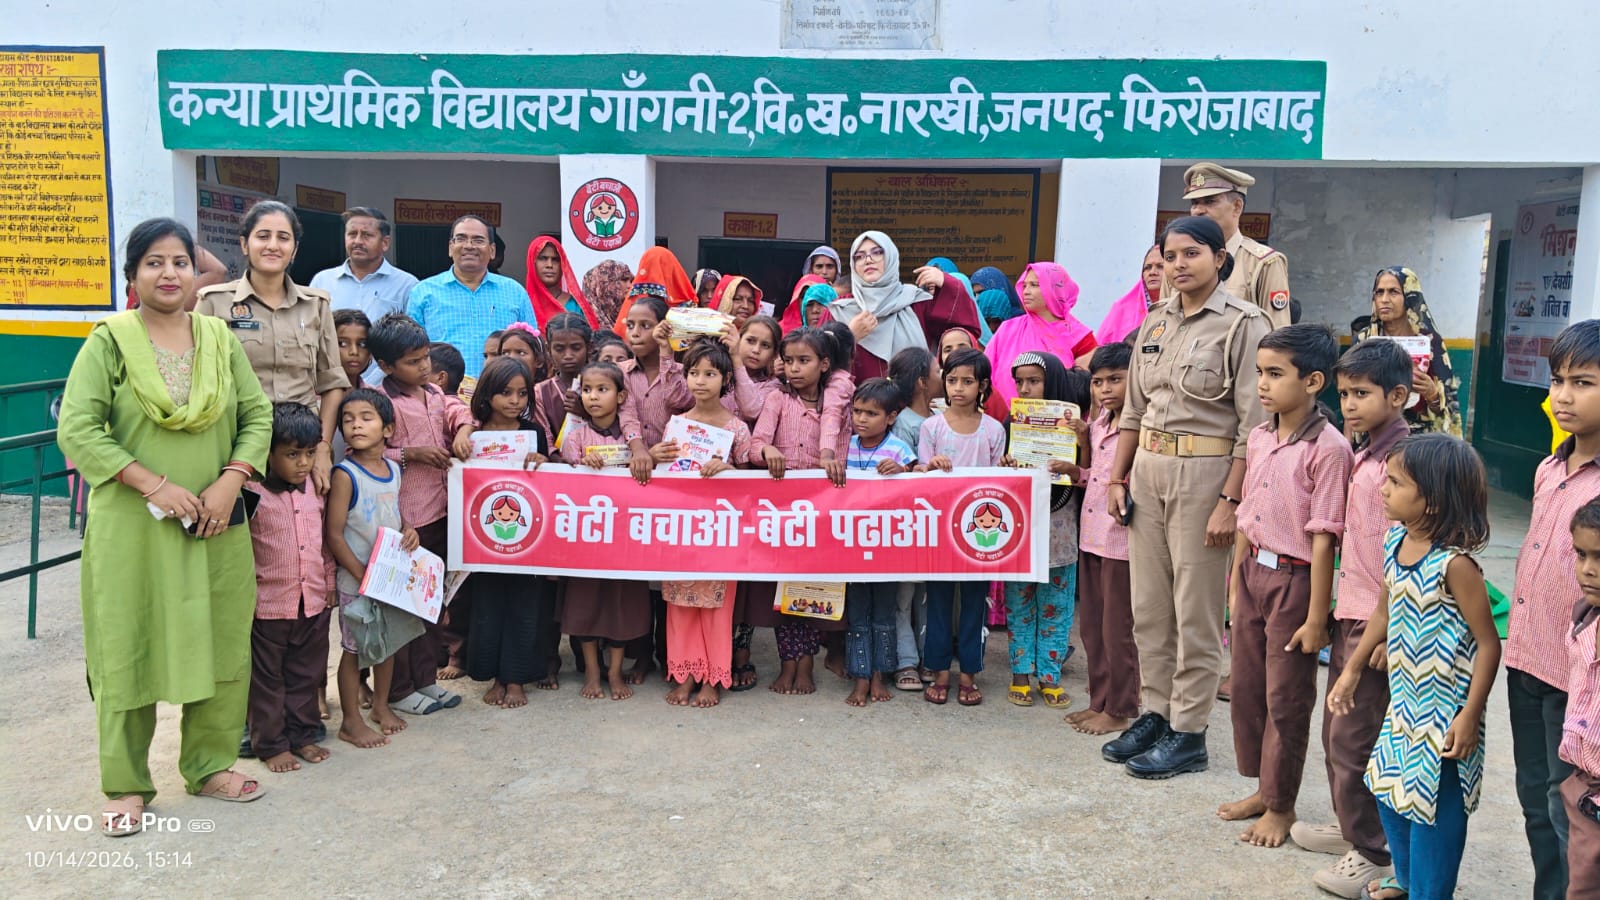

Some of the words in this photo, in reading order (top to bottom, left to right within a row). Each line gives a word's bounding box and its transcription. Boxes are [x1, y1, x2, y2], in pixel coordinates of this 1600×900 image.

[18, 63, 45, 77] शपथ
[9, 88, 32, 99] विद्यालय
[168, 81, 267, 127] कन्या
[266, 69, 425, 129] प्राथमिक
[428, 69, 588, 132] विद्यालय
[26, 119, 50, 130] विद्यालय
[44, 130, 67, 141] विद्यालय
[585, 181, 600, 194] बेटी
[600, 181, 623, 193] बचाओ
[914, 174, 958, 189] अधिकार
[585, 234, 602, 247] बेटी
[553, 493, 619, 544] बेटी
[828, 497, 943, 560] पढ़ाओ
